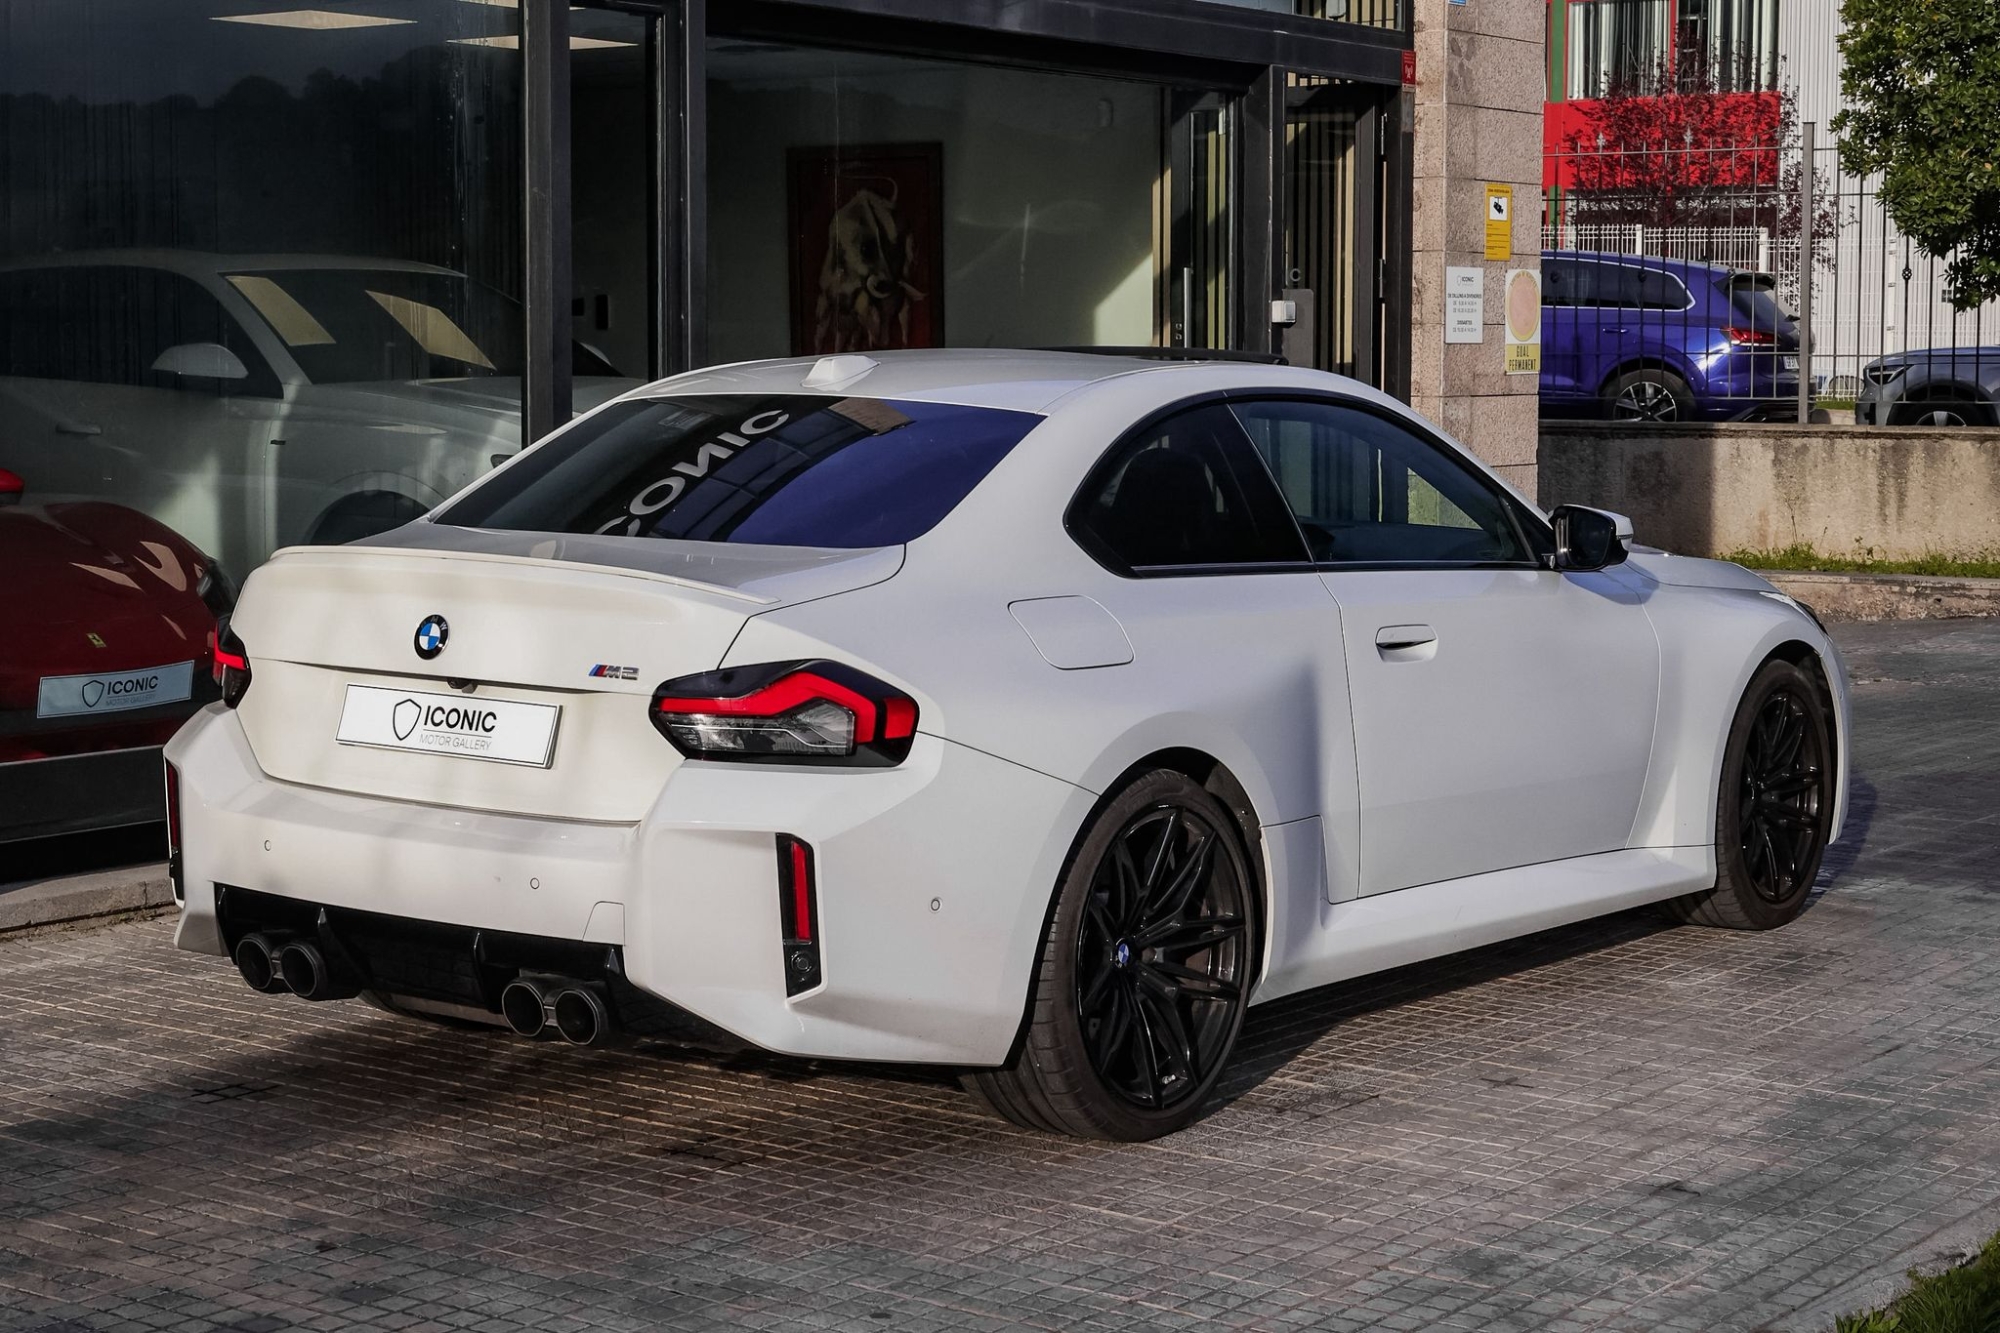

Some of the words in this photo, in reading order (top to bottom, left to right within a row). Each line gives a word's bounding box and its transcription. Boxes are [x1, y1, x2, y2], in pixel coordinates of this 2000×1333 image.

[1516, 345, 1529, 357] GUAL
[1509, 358, 1536, 371] PERMANENT
[602, 665, 639, 680] M2
[107, 675, 159, 695] ICONIC
[106, 696, 130, 706] MOTOR
[131, 694, 156, 704] GALLERY
[423, 705, 497, 733] ICONIC
[419, 733, 452, 748] MOTOR
[452, 736, 492, 751] GALLERY
